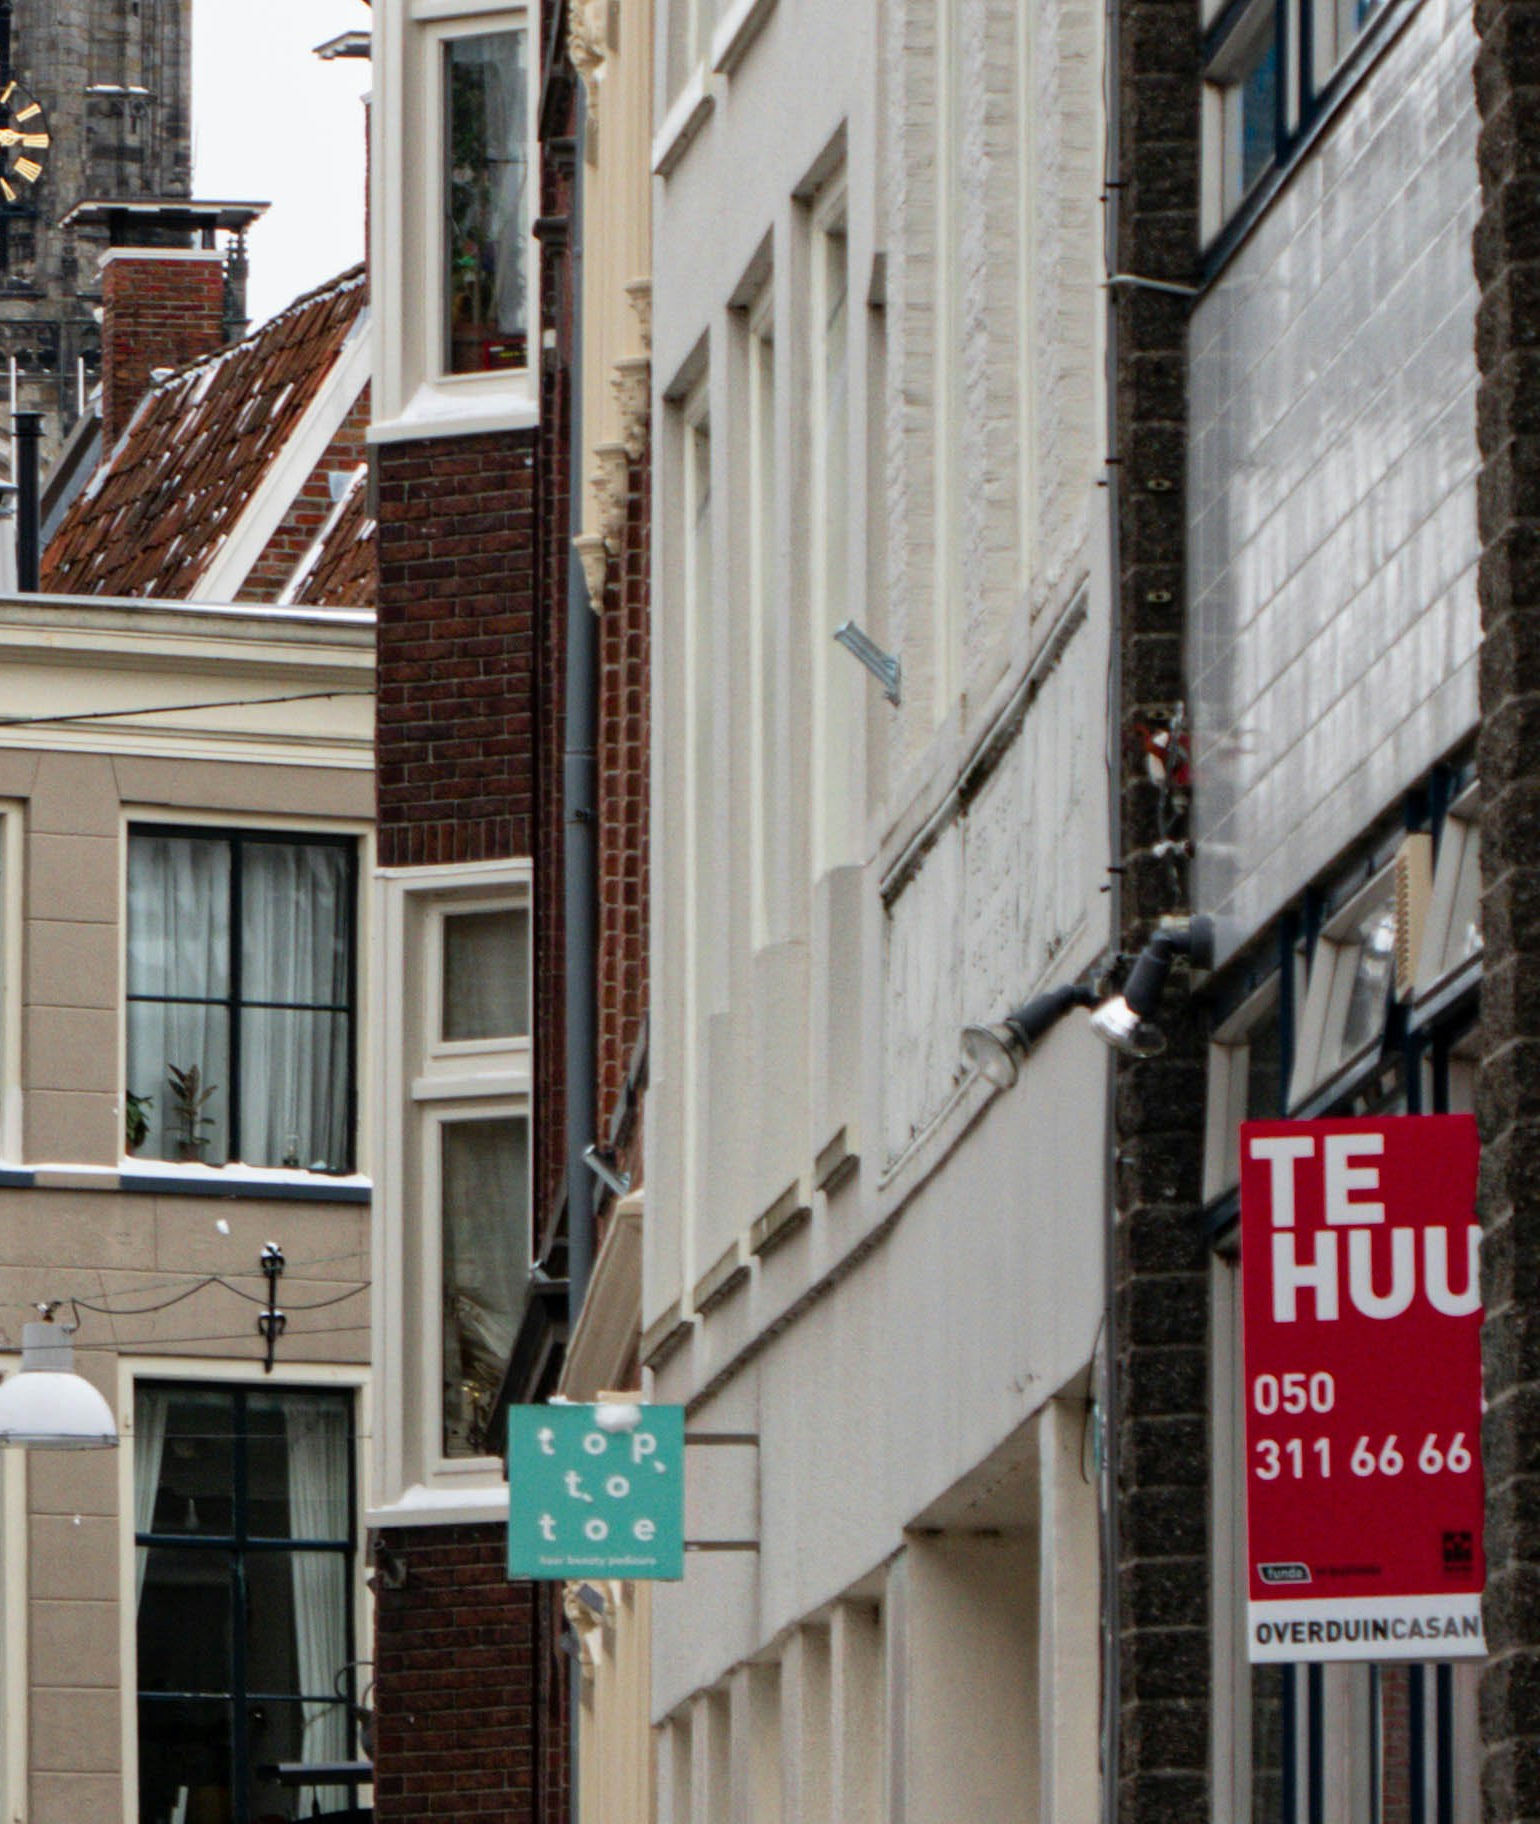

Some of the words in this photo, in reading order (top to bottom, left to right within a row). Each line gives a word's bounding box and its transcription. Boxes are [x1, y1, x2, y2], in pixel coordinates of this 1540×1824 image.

[1249, 1133, 1386, 1228] TE
[1253, 1372, 1335, 1416] 050
[538, 1428, 657, 1464] top
[1255, 1438, 1330, 1480] 311
[1350, 1435, 1403, 1476] 66
[1417, 1432, 1472, 1474] 66
[564, 1470, 630, 1498] to
[539, 1514, 656, 1542] toe
[1267, 1567, 1302, 1578] funda
